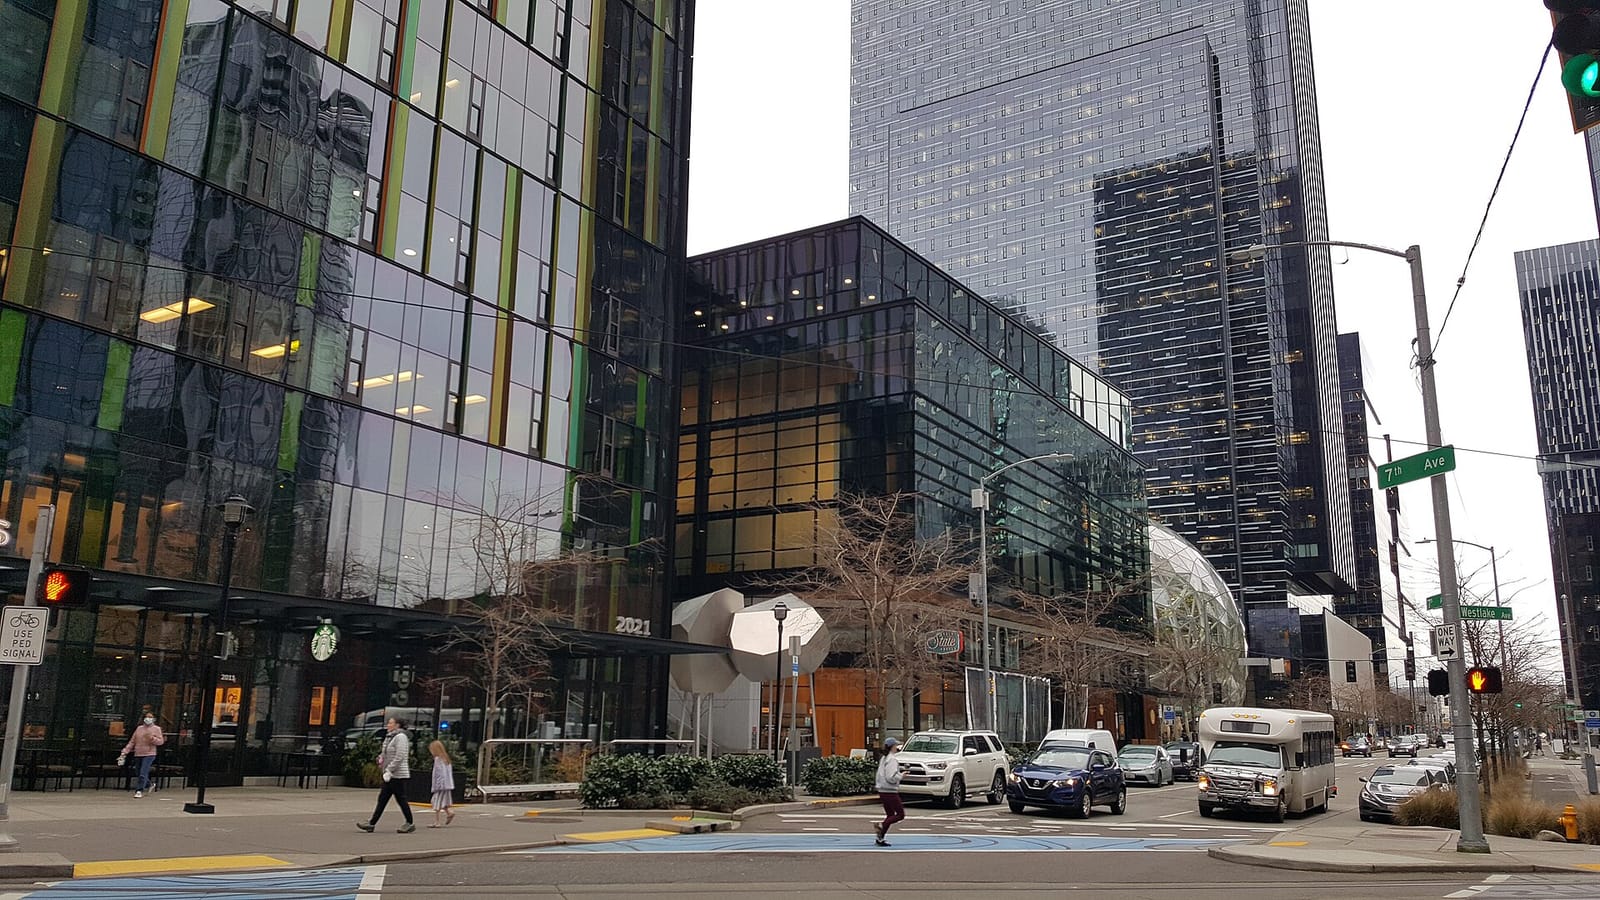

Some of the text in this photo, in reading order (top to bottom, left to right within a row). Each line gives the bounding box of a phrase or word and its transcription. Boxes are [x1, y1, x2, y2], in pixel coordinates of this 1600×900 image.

[1384, 456, 1445, 482] 7th Ave
[1461, 607, 1496, 618] Westlake
[615, 615, 651, 636] 2021
[13, 629, 33, 639] USE
[1437, 626, 1454, 637] ONE
[12, 639, 31, 648] PED
[1438, 636, 1455, 647] WAY
[2, 649, 37, 659] SIGNAL
